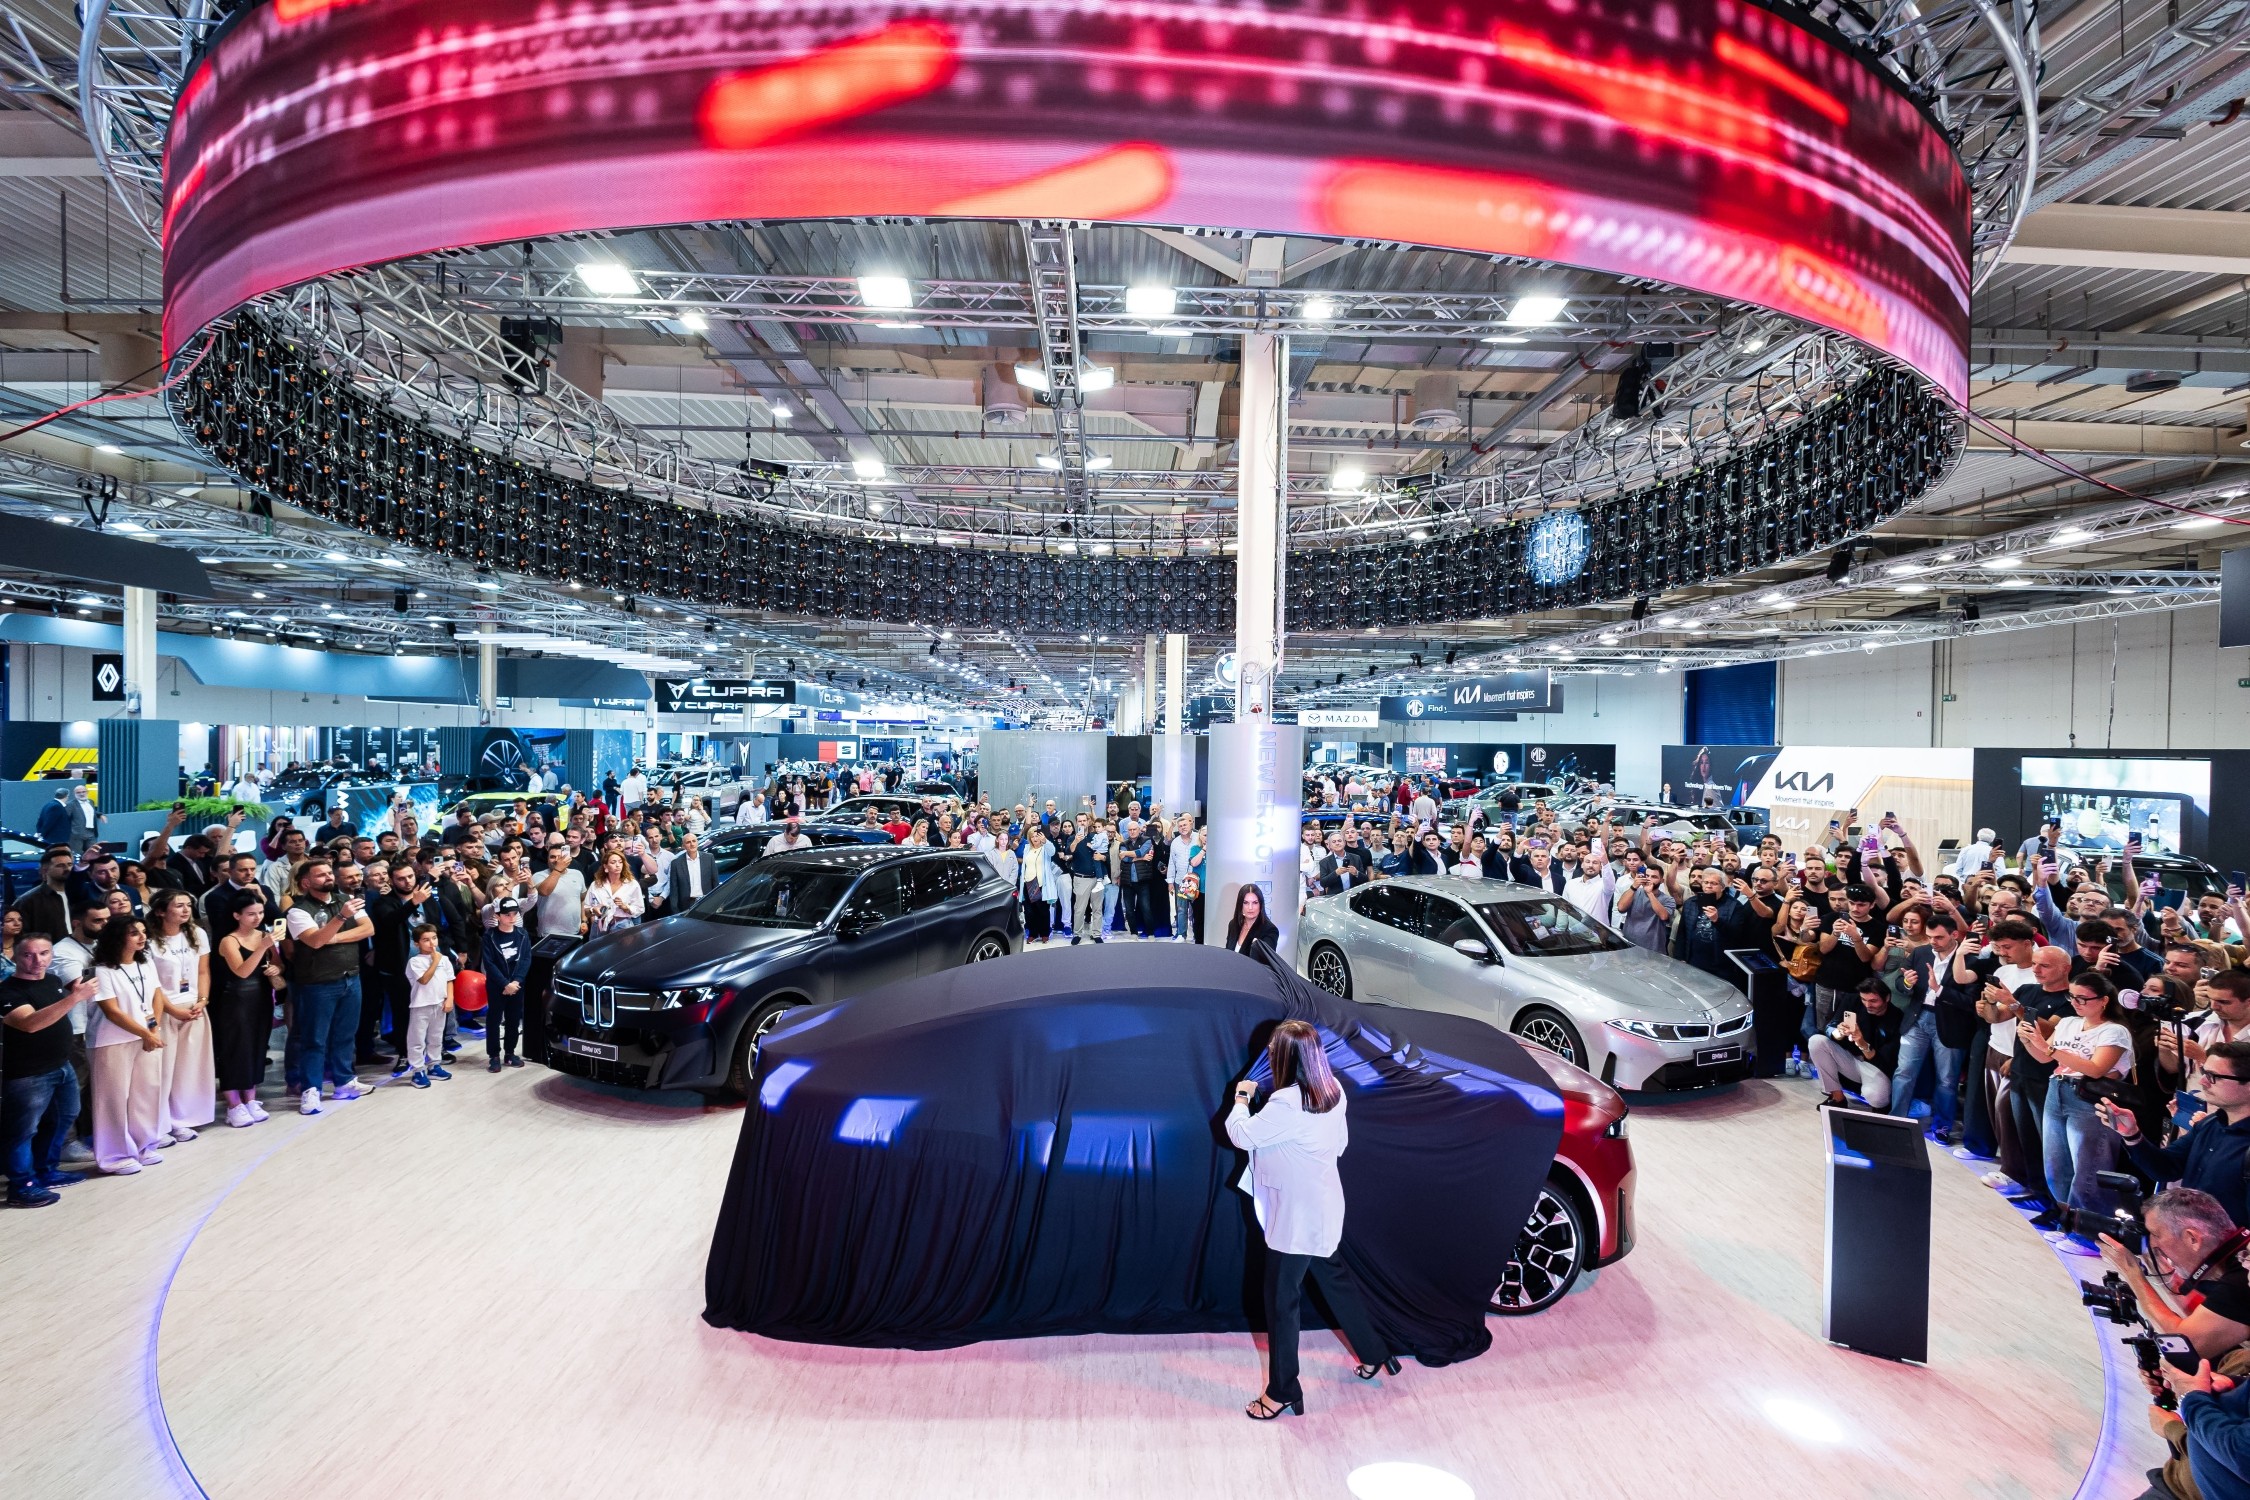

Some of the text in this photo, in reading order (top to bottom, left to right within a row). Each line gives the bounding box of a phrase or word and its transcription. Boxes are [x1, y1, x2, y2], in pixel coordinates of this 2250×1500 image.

[692, 686, 784, 698] CUPRA
[1454, 684, 1481, 705] KIA
[1506, 689, 1515, 701] that
[1516, 688, 1535, 702] inspires
[1428, 704, 1443, 712] Find
[1326, 715, 1368, 723] MAZDA
[1258, 731, 1277, 784] NEW
[1531, 748, 1546, 762] MG
[1776, 771, 1834, 793] KIA
[1775, 795, 1802, 803] Movement
[1255, 789, 1275, 838] ERA
[1254, 844, 1275, 875] OF
